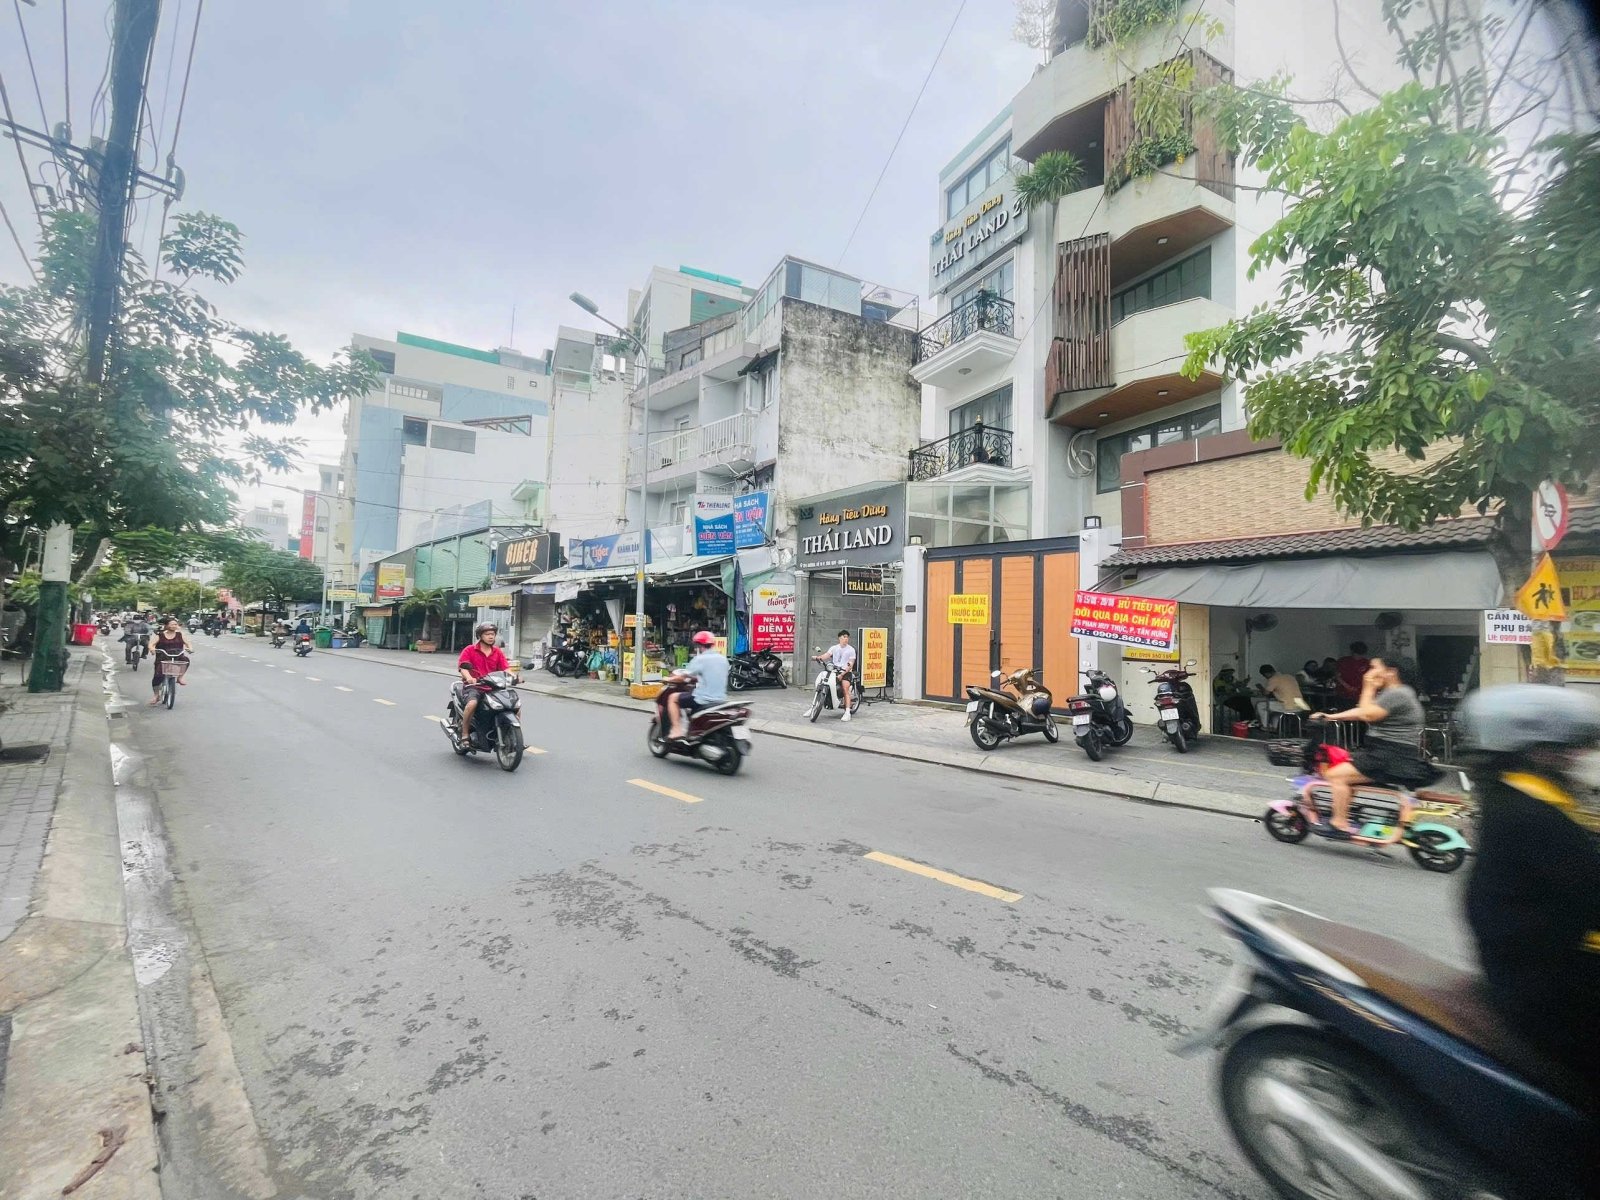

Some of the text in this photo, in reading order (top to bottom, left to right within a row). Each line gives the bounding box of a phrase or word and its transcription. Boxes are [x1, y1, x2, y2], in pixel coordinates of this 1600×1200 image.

[932, 242, 964, 277] THÁI
[968, 210, 1009, 252] LAND
[802, 524, 893, 555] THÁI LAND
[591, 544, 608, 562] Tiger
[848, 580, 882, 592] THÁI LAND
[980, 597, 986, 605] XE
[1118, 597, 1130, 609] HỦ
[1132, 598, 1153, 611] TIẾU
[1082, 620, 1098, 628] PHAN
[1092, 610, 1111, 621] QUA
[1113, 612, 1129, 624] ĐỊA
[1132, 614, 1149, 626] CHỈ
[1151, 616, 1170, 628] MỚI
[757, 623, 795, 633] ĐIỀN V
[1073, 627, 1166, 647] ĐT: 0909.860.169
